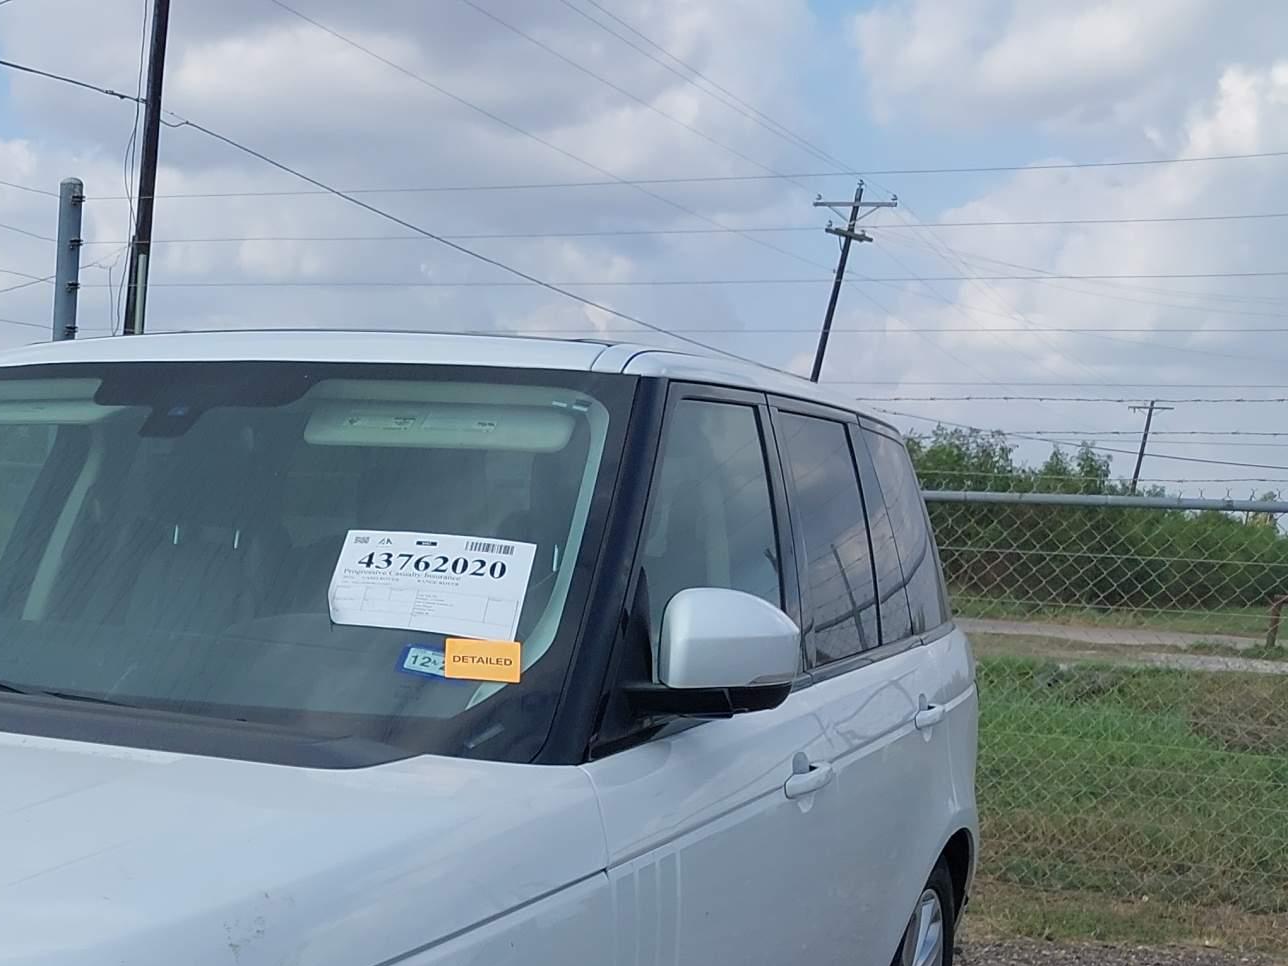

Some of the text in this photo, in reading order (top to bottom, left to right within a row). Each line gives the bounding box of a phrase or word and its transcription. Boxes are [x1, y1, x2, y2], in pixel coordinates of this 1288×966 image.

[358, 552, 507, 580] 43762020
[424, 573, 461, 582] Insurance
[452, 655, 513, 667] DETAILED
